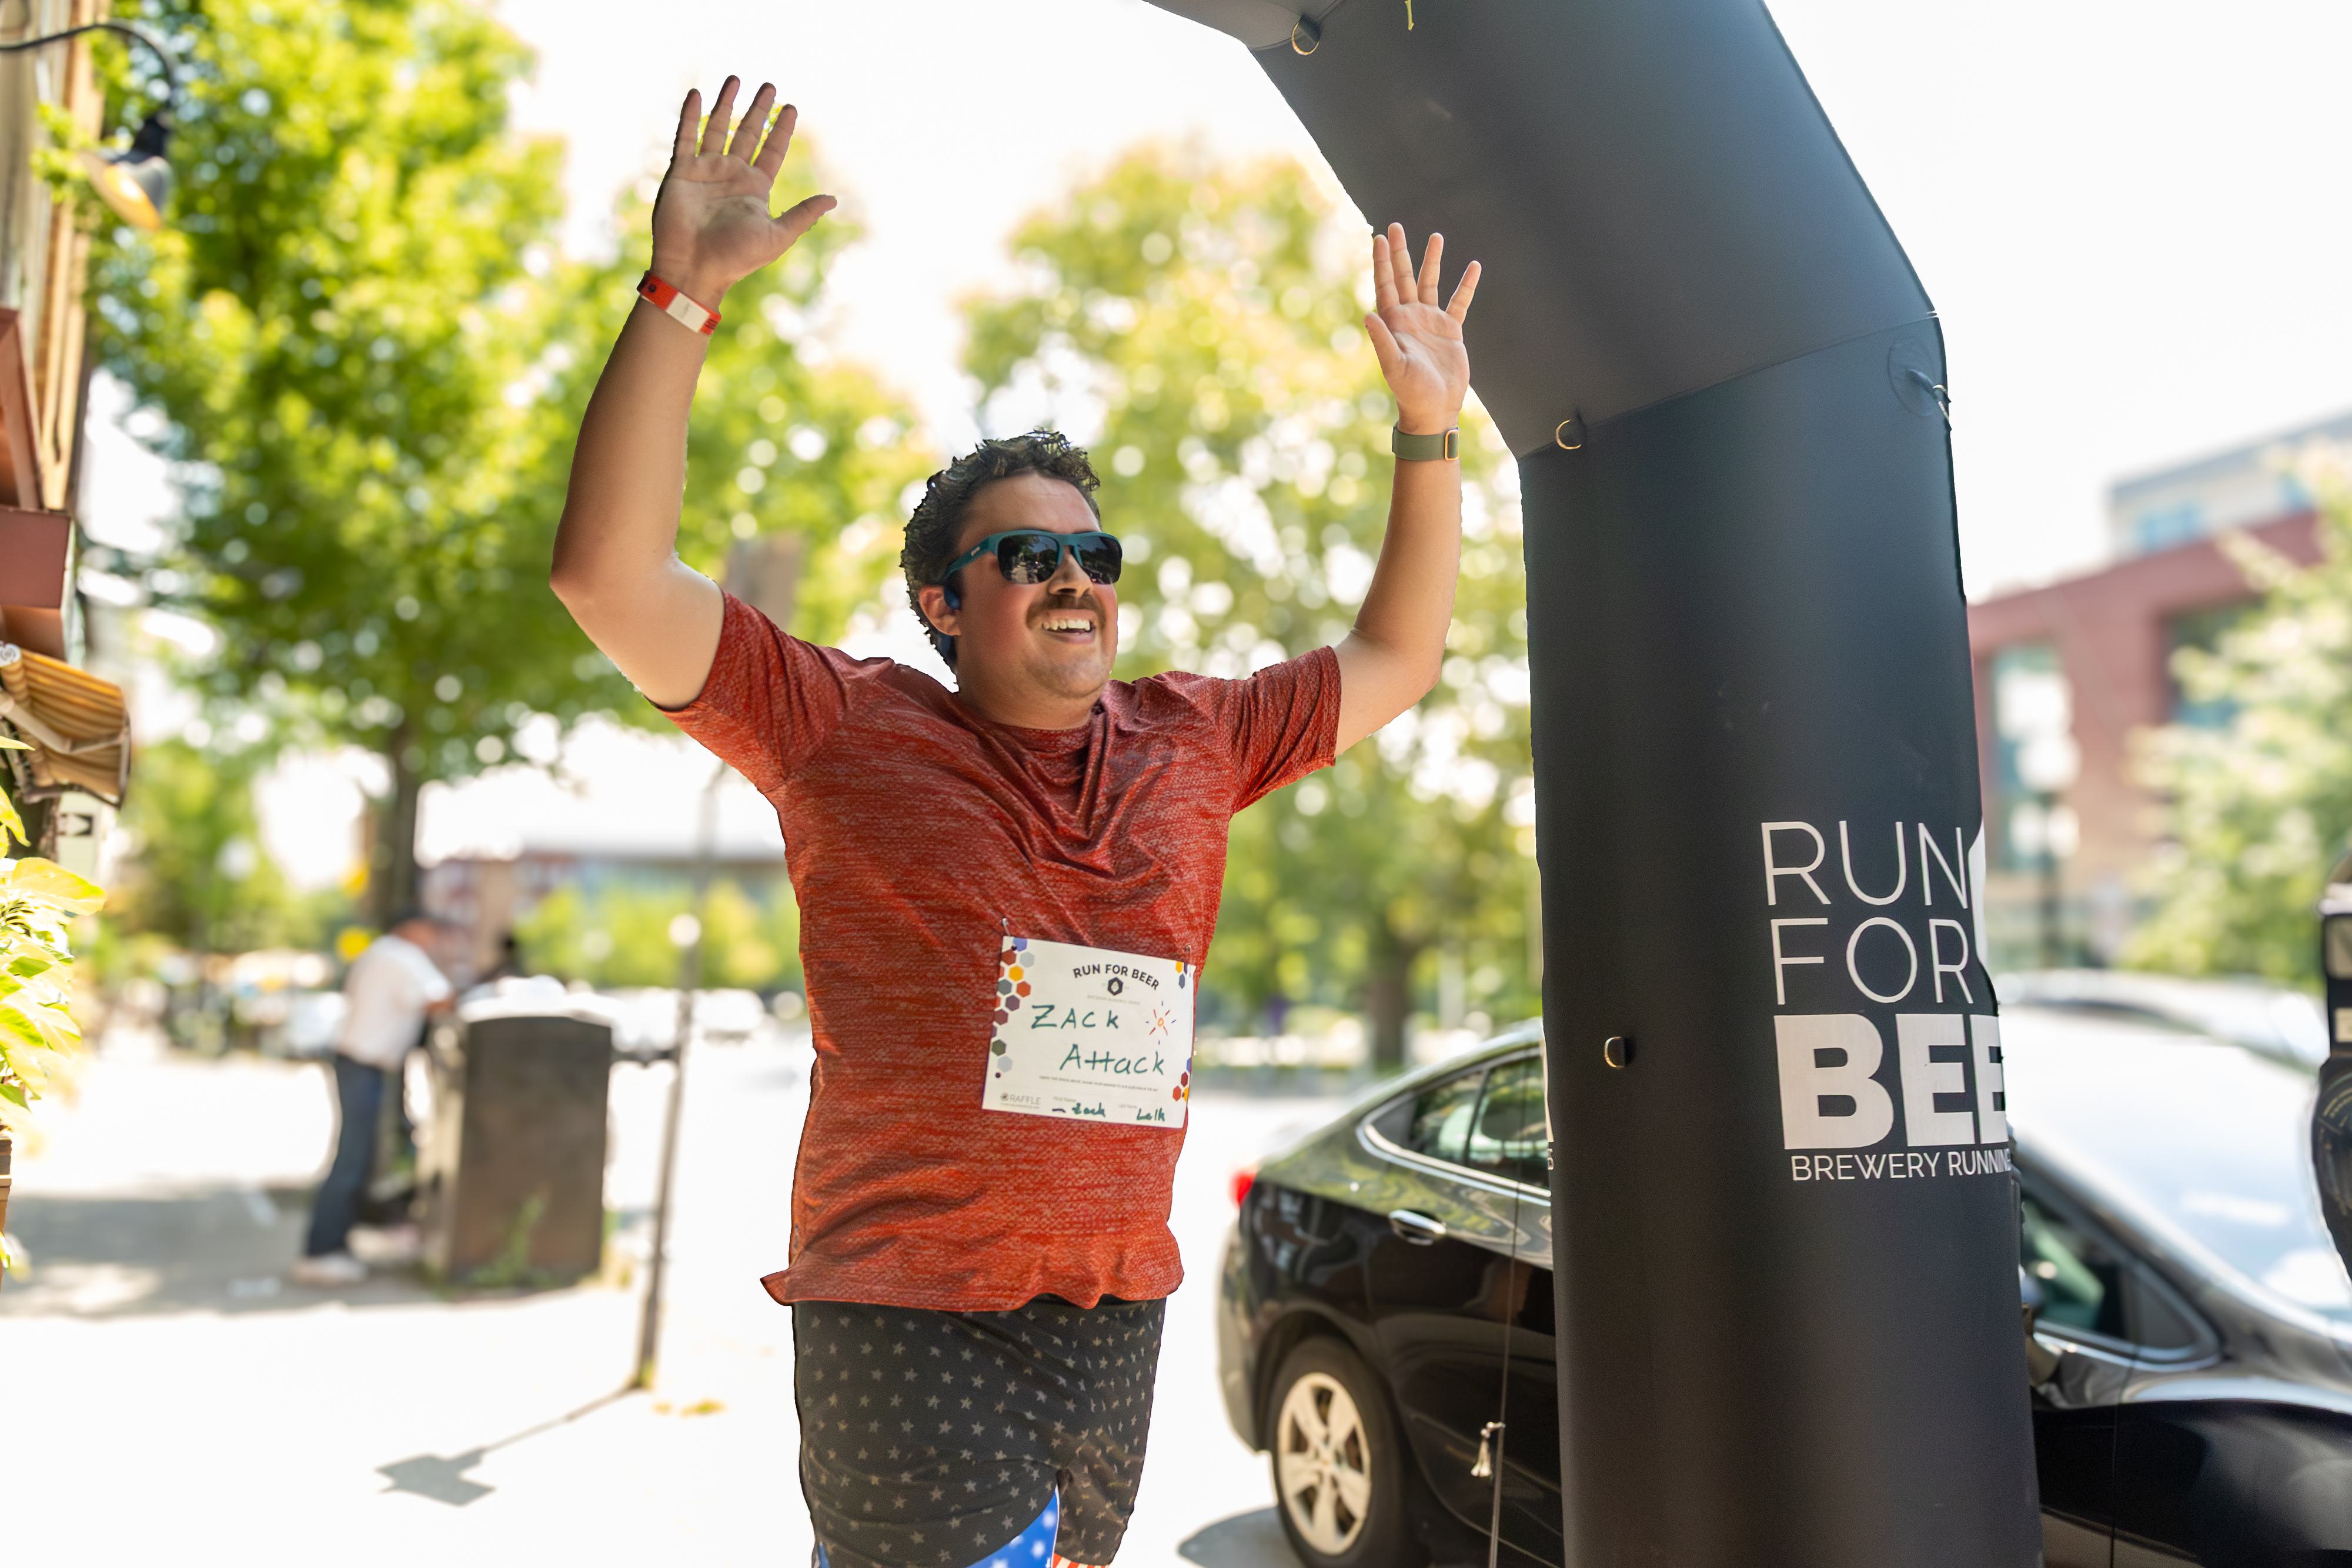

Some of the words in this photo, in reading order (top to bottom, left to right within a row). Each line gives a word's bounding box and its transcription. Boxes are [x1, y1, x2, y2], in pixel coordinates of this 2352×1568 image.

[1762, 821, 1967, 908] RUN
[1770, 917, 1973, 1005] FOR
[1073, 964, 1100, 978] RUN
[1105, 964, 1128, 976] FOR
[1131, 968, 1159, 990] BEER
[1060, 1044, 1164, 1075] Attack
[1010, 1094, 1041, 1105] RAFFLE
[1791, 1152, 1940, 1181] BREWERY
